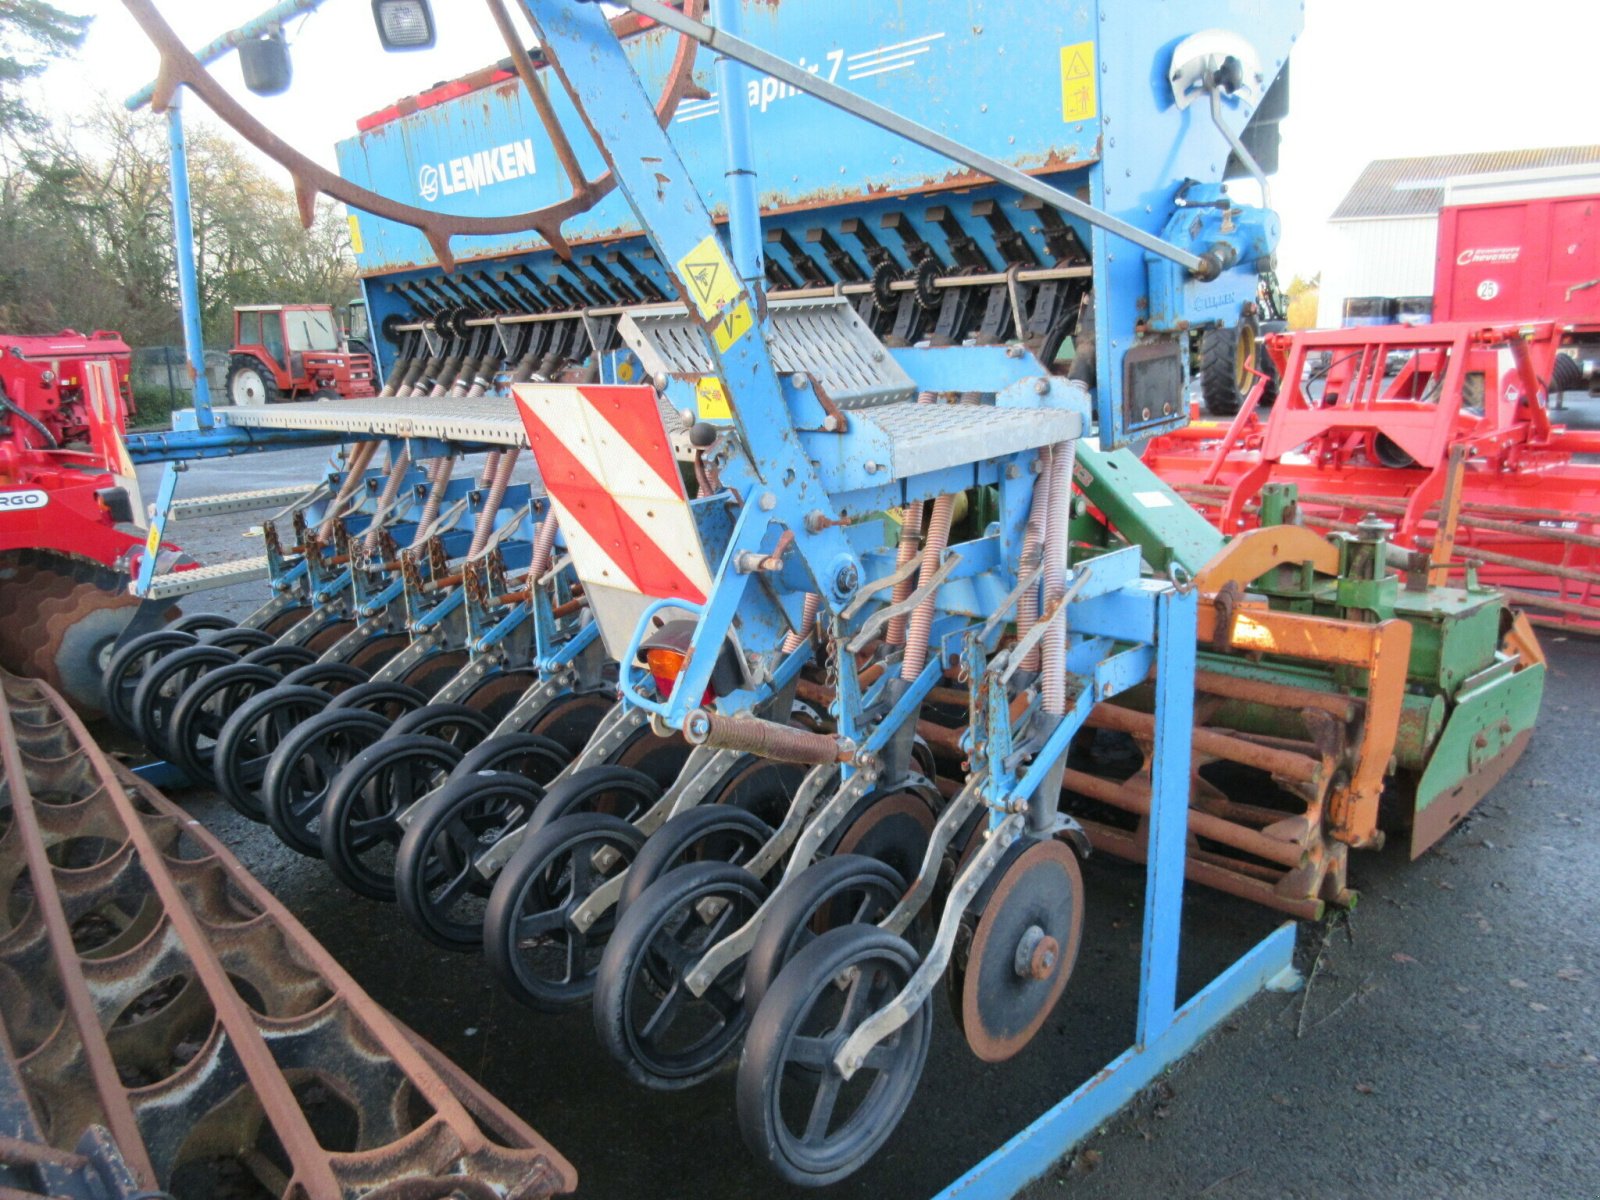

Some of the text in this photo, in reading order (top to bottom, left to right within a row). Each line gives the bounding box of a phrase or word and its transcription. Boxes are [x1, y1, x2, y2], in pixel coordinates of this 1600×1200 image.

[826, 48, 844, 84] 7
[438, 138, 536, 197] LEMKEN
[1481, 282, 1495, 298] 25
